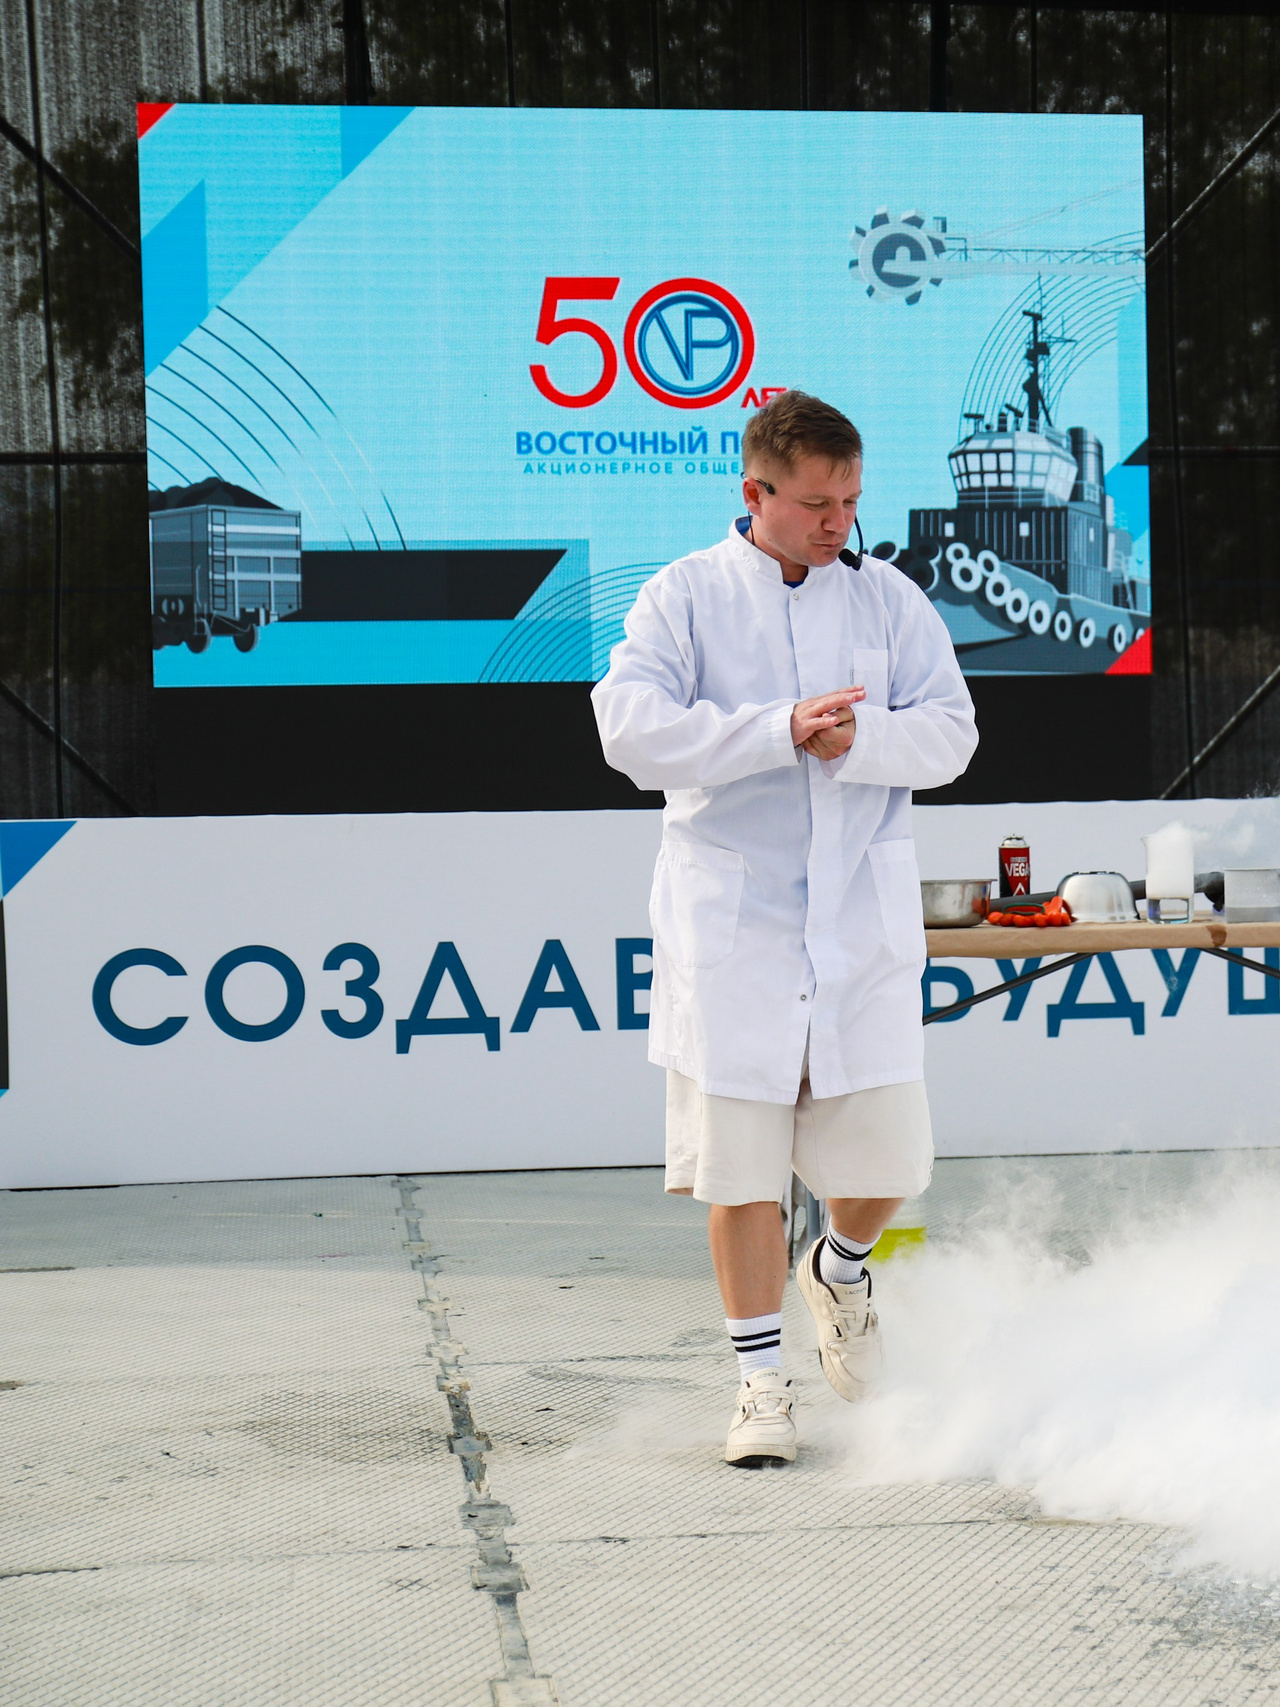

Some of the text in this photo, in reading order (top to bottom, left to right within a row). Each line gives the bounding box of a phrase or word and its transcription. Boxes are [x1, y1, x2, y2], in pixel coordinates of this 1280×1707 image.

[516, 427, 708, 455] ВОСТОЧНЫЙ
[523, 462, 739, 476] АКЦИОНЕРНОЕ ОБЩЕ
[92, 938, 656, 1055] СОЗДАВ
